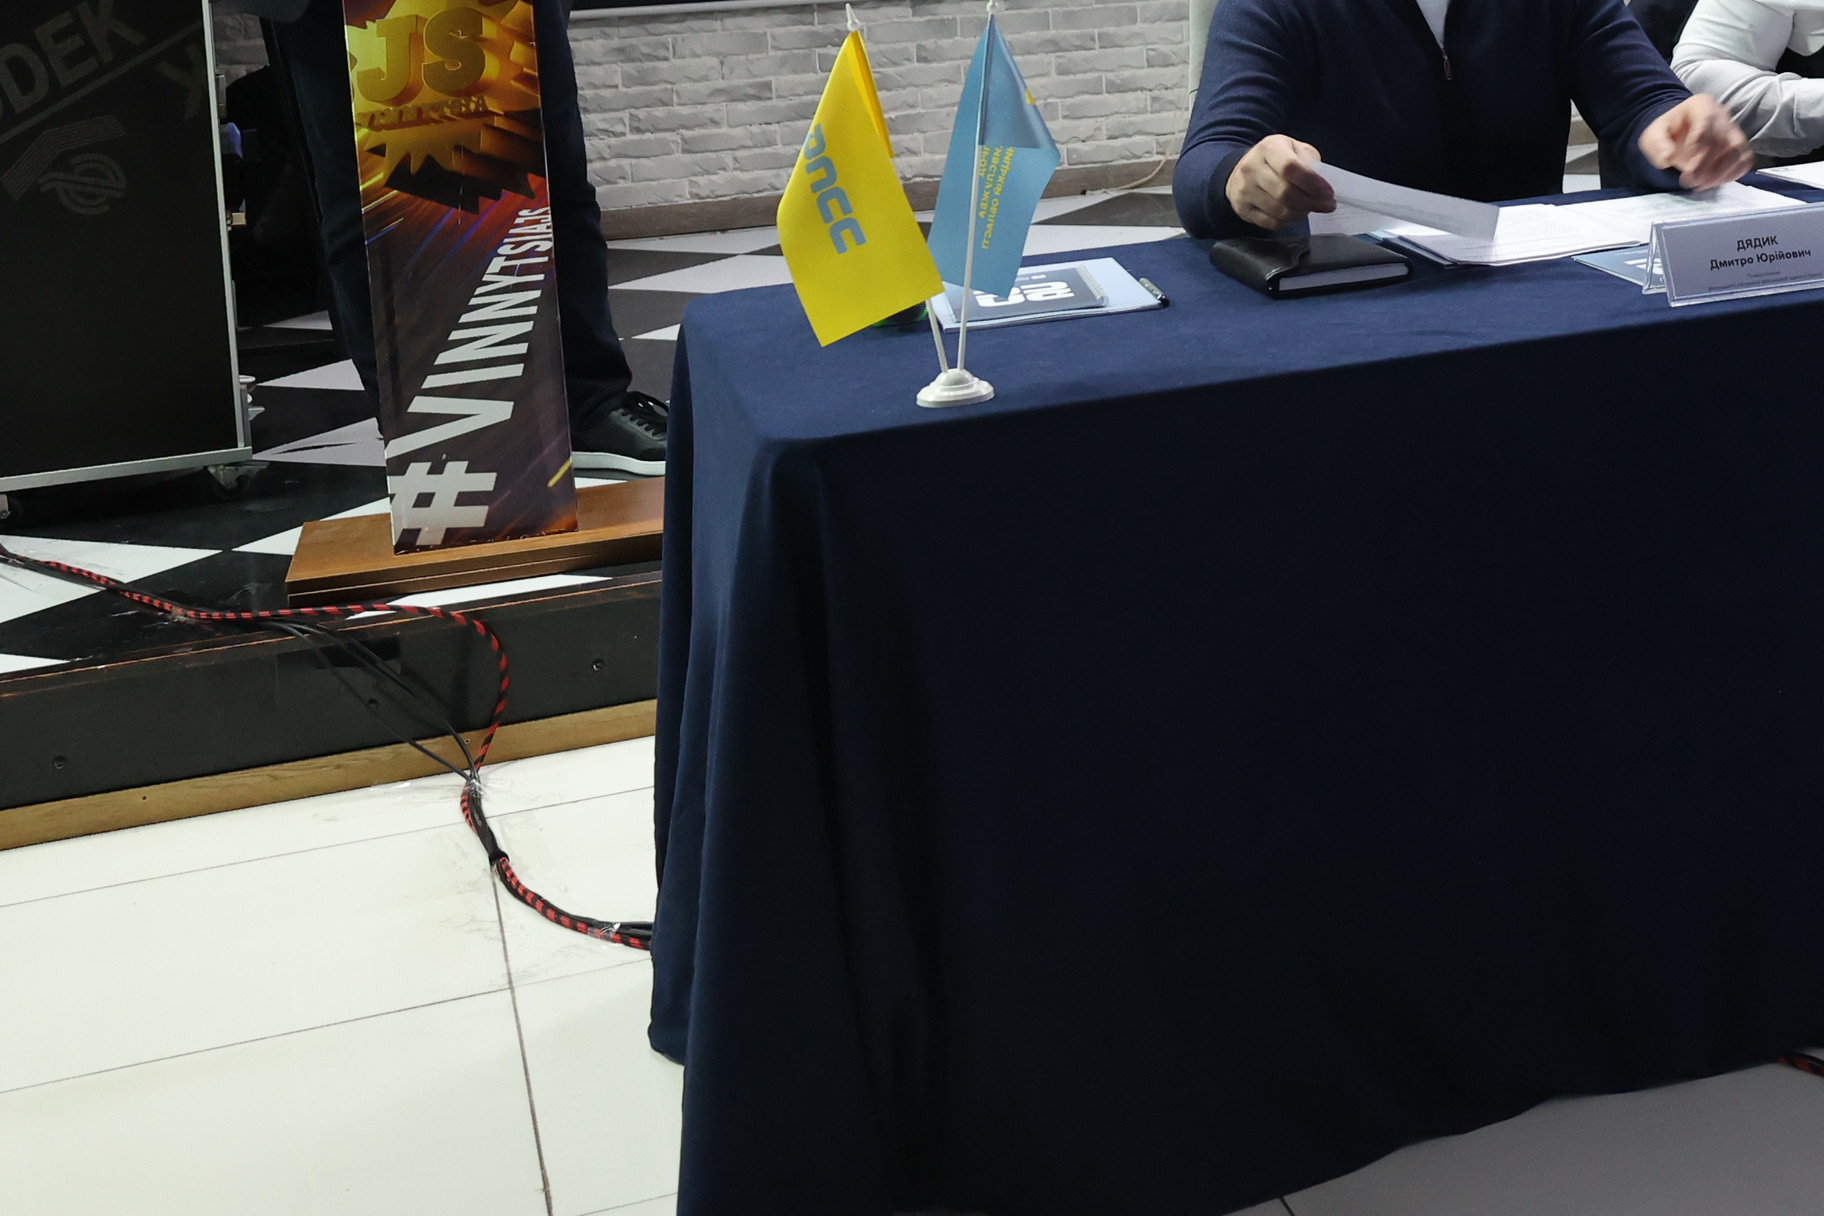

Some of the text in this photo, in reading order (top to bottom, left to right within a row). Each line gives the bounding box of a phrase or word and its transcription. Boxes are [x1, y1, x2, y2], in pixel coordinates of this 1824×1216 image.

[1736, 236, 1778, 252] ДЯДИК
[1710, 249, 1811, 271] Дмитро Юрійович
